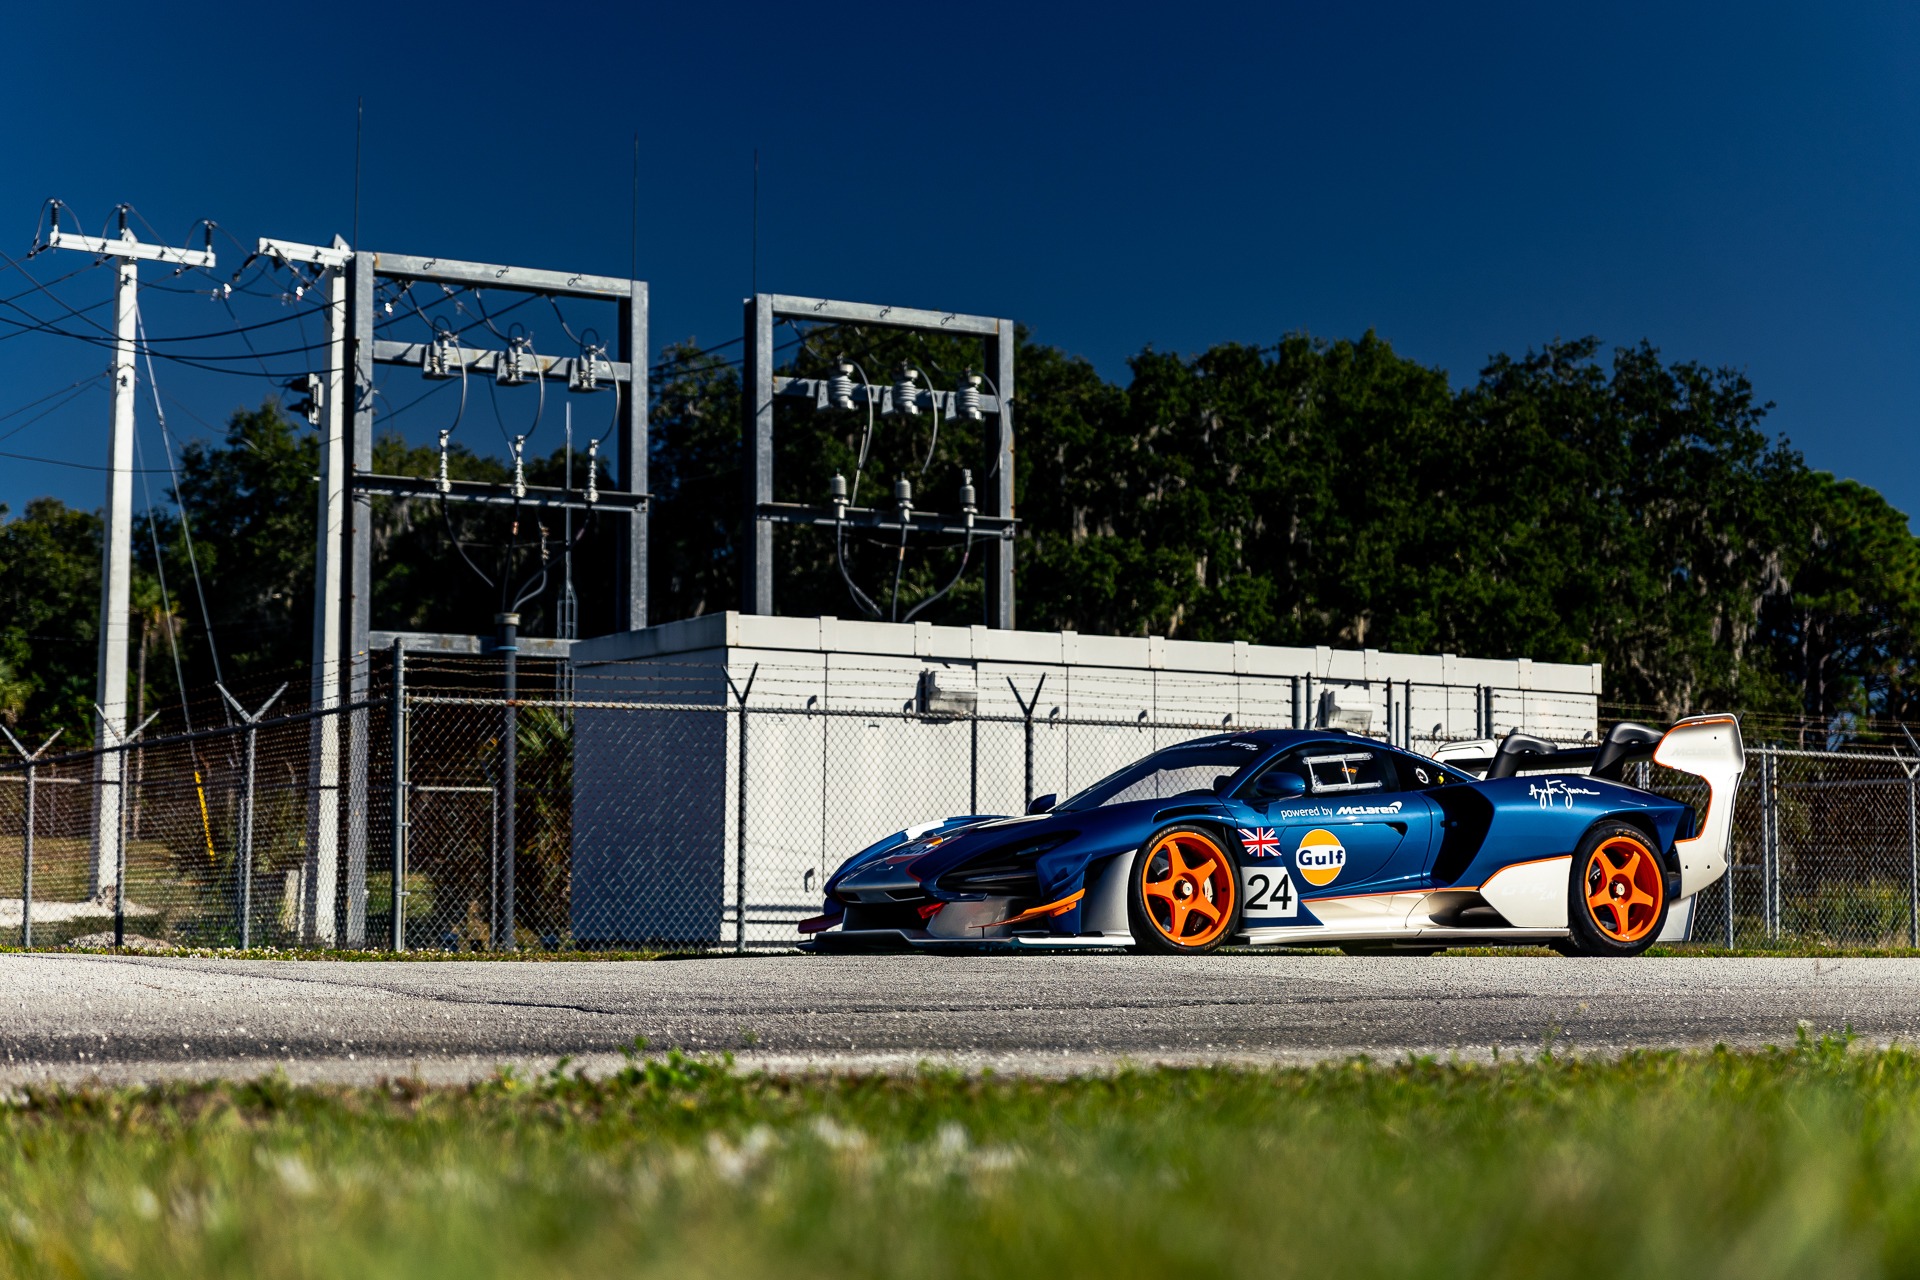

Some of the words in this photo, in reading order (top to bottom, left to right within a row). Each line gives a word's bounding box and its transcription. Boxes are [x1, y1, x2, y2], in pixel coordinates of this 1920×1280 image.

[1280, 807, 1320, 820] powered
[1321, 806, 1333, 818] by
[1336, 801, 1403, 815] McLaren
[1298, 850, 1344, 866] Gulf
[1244, 874, 1292, 911] 24
